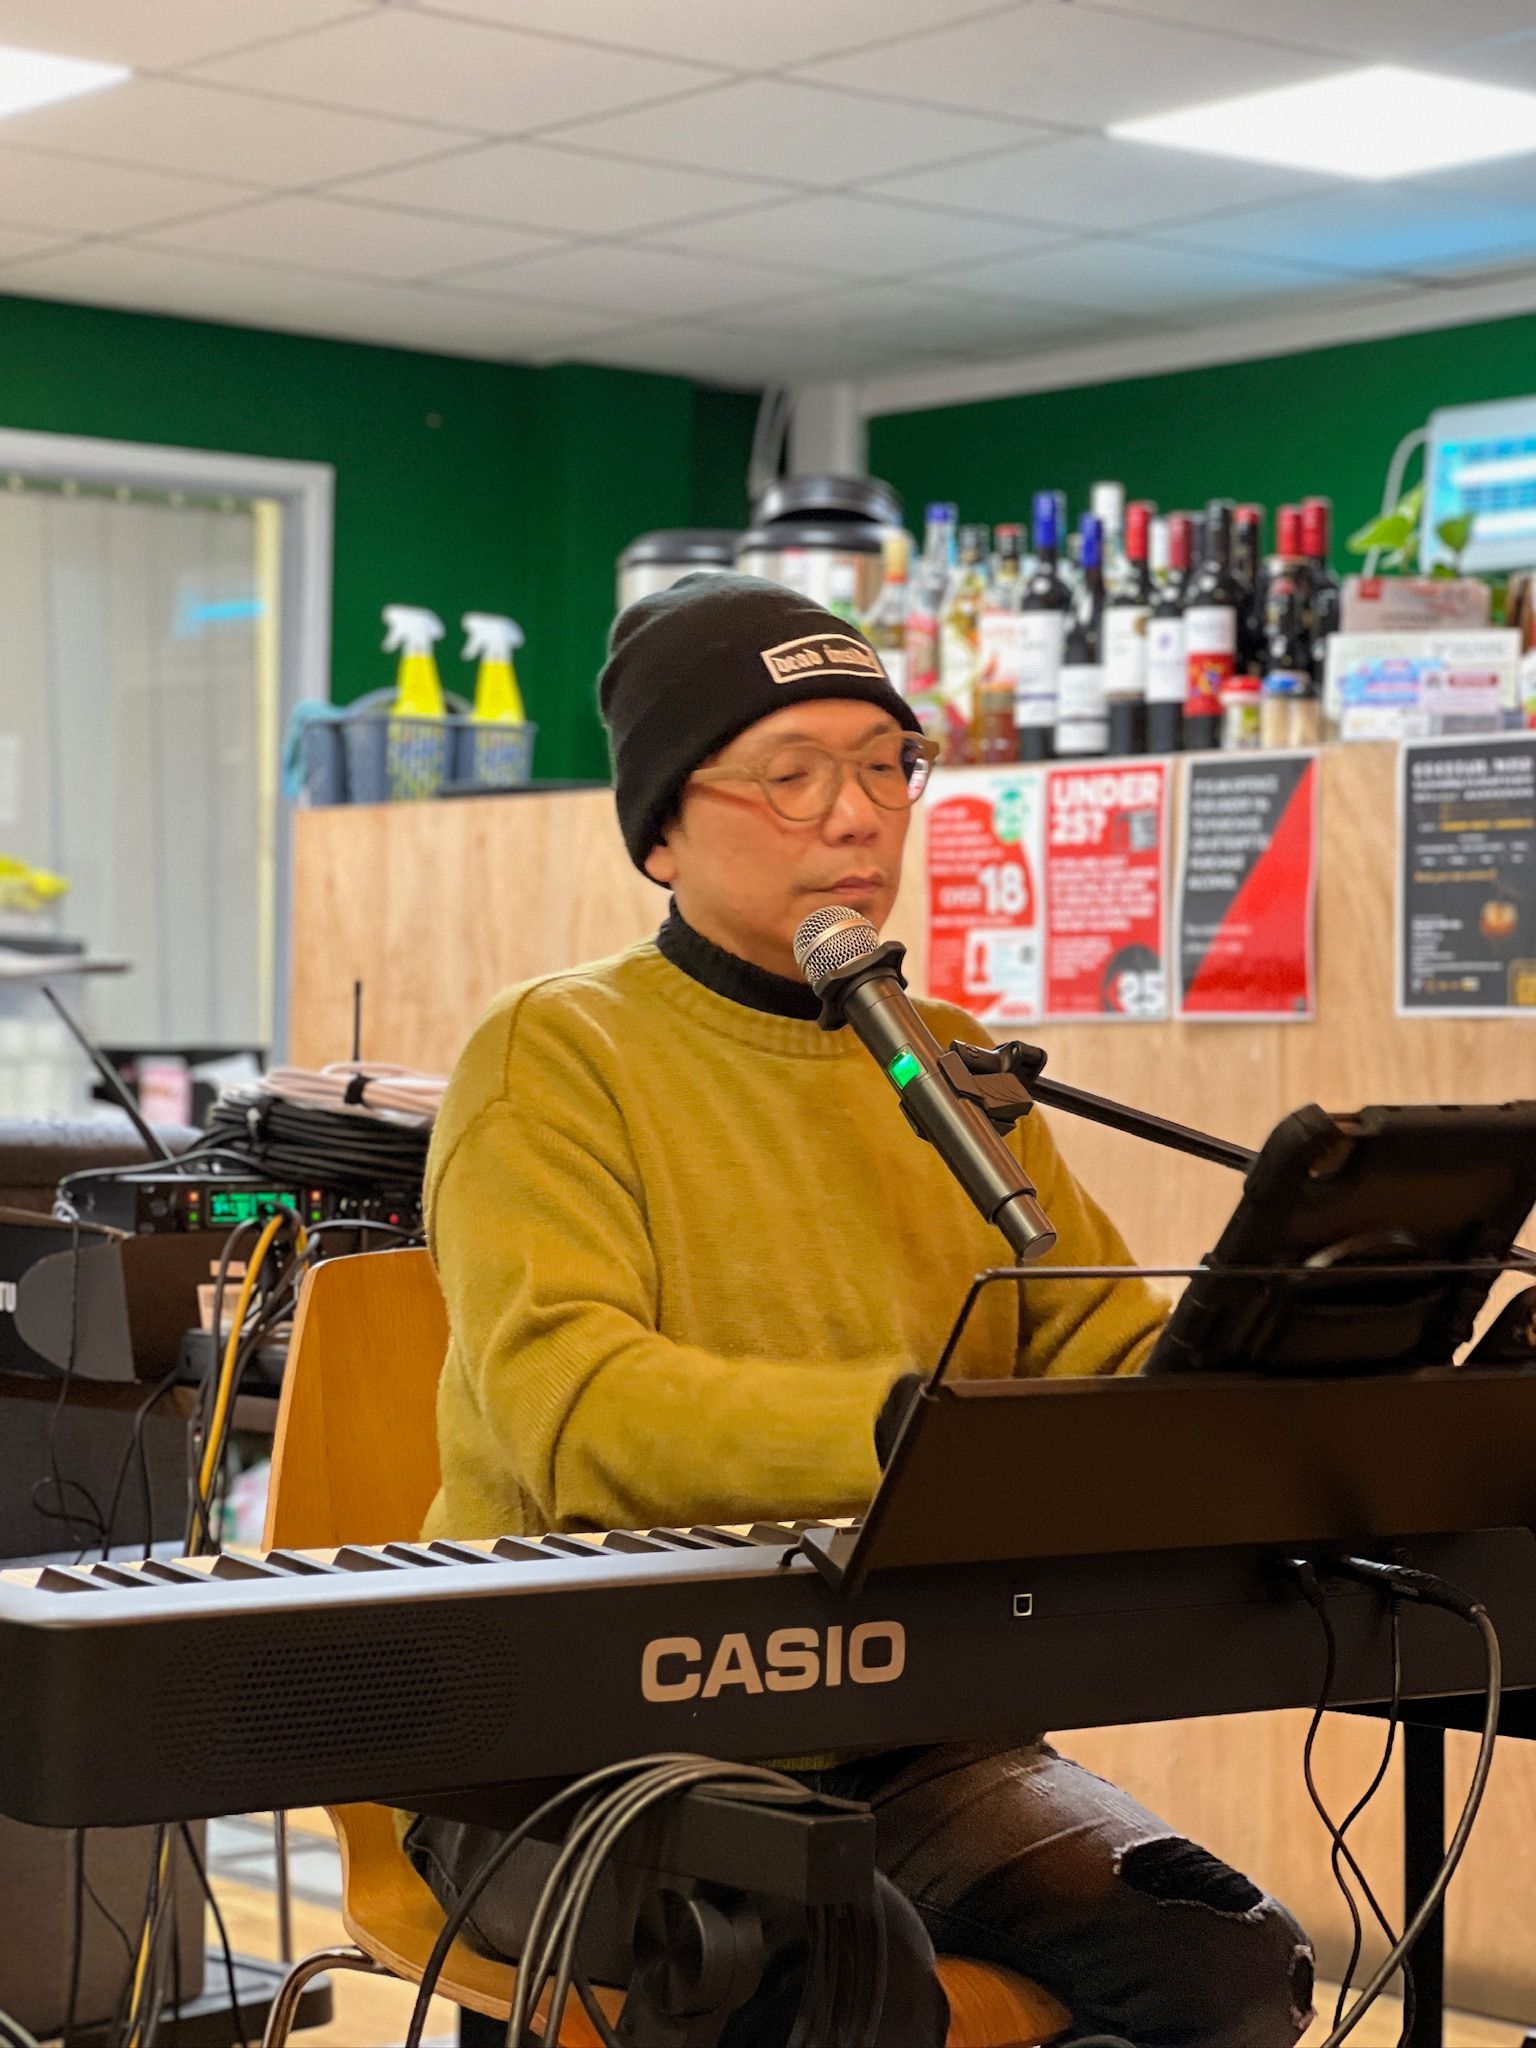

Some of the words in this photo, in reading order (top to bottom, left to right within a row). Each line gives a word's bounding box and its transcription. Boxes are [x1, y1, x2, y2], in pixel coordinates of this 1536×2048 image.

[1053, 773, 1158, 806] UNDER
[1053, 811, 1106, 844] 25?
[979, 863, 1028, 915] 18
[1118, 971, 1165, 1011] 25
[641, 1621, 905, 1703] CASIO
